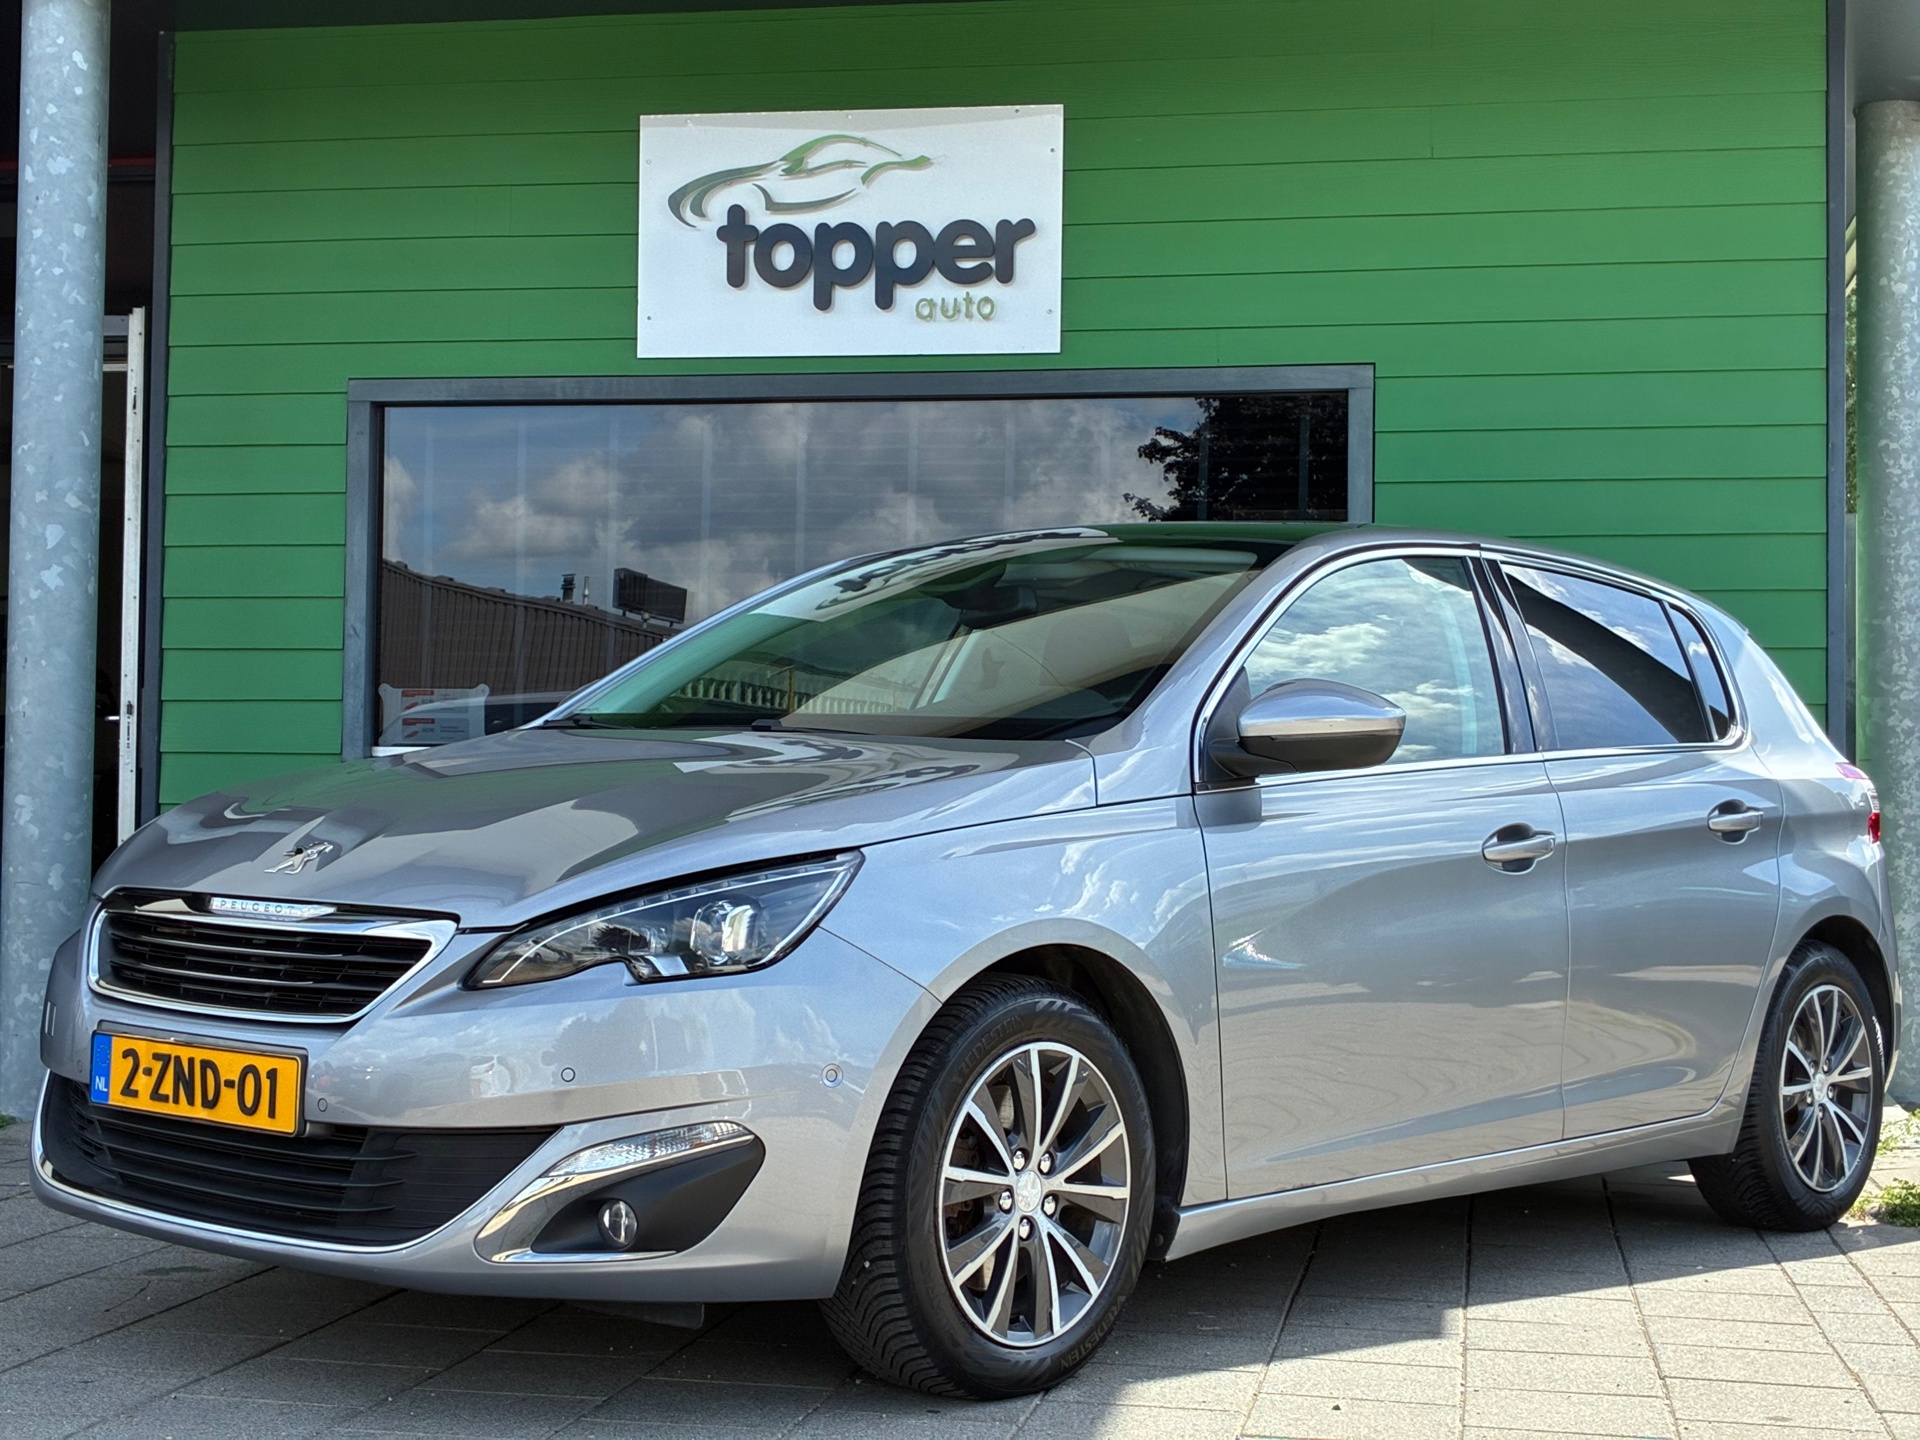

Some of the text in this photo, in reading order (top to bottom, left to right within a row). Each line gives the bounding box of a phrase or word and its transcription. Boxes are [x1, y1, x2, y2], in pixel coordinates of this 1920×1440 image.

[716, 204, 1036, 311] topper
[915, 291, 996, 320] auto
[220, 899, 296, 915] PEUGEOT
[94, 1075, 108, 1093] NL
[119, 1047, 278, 1119] 2-ZND-01
